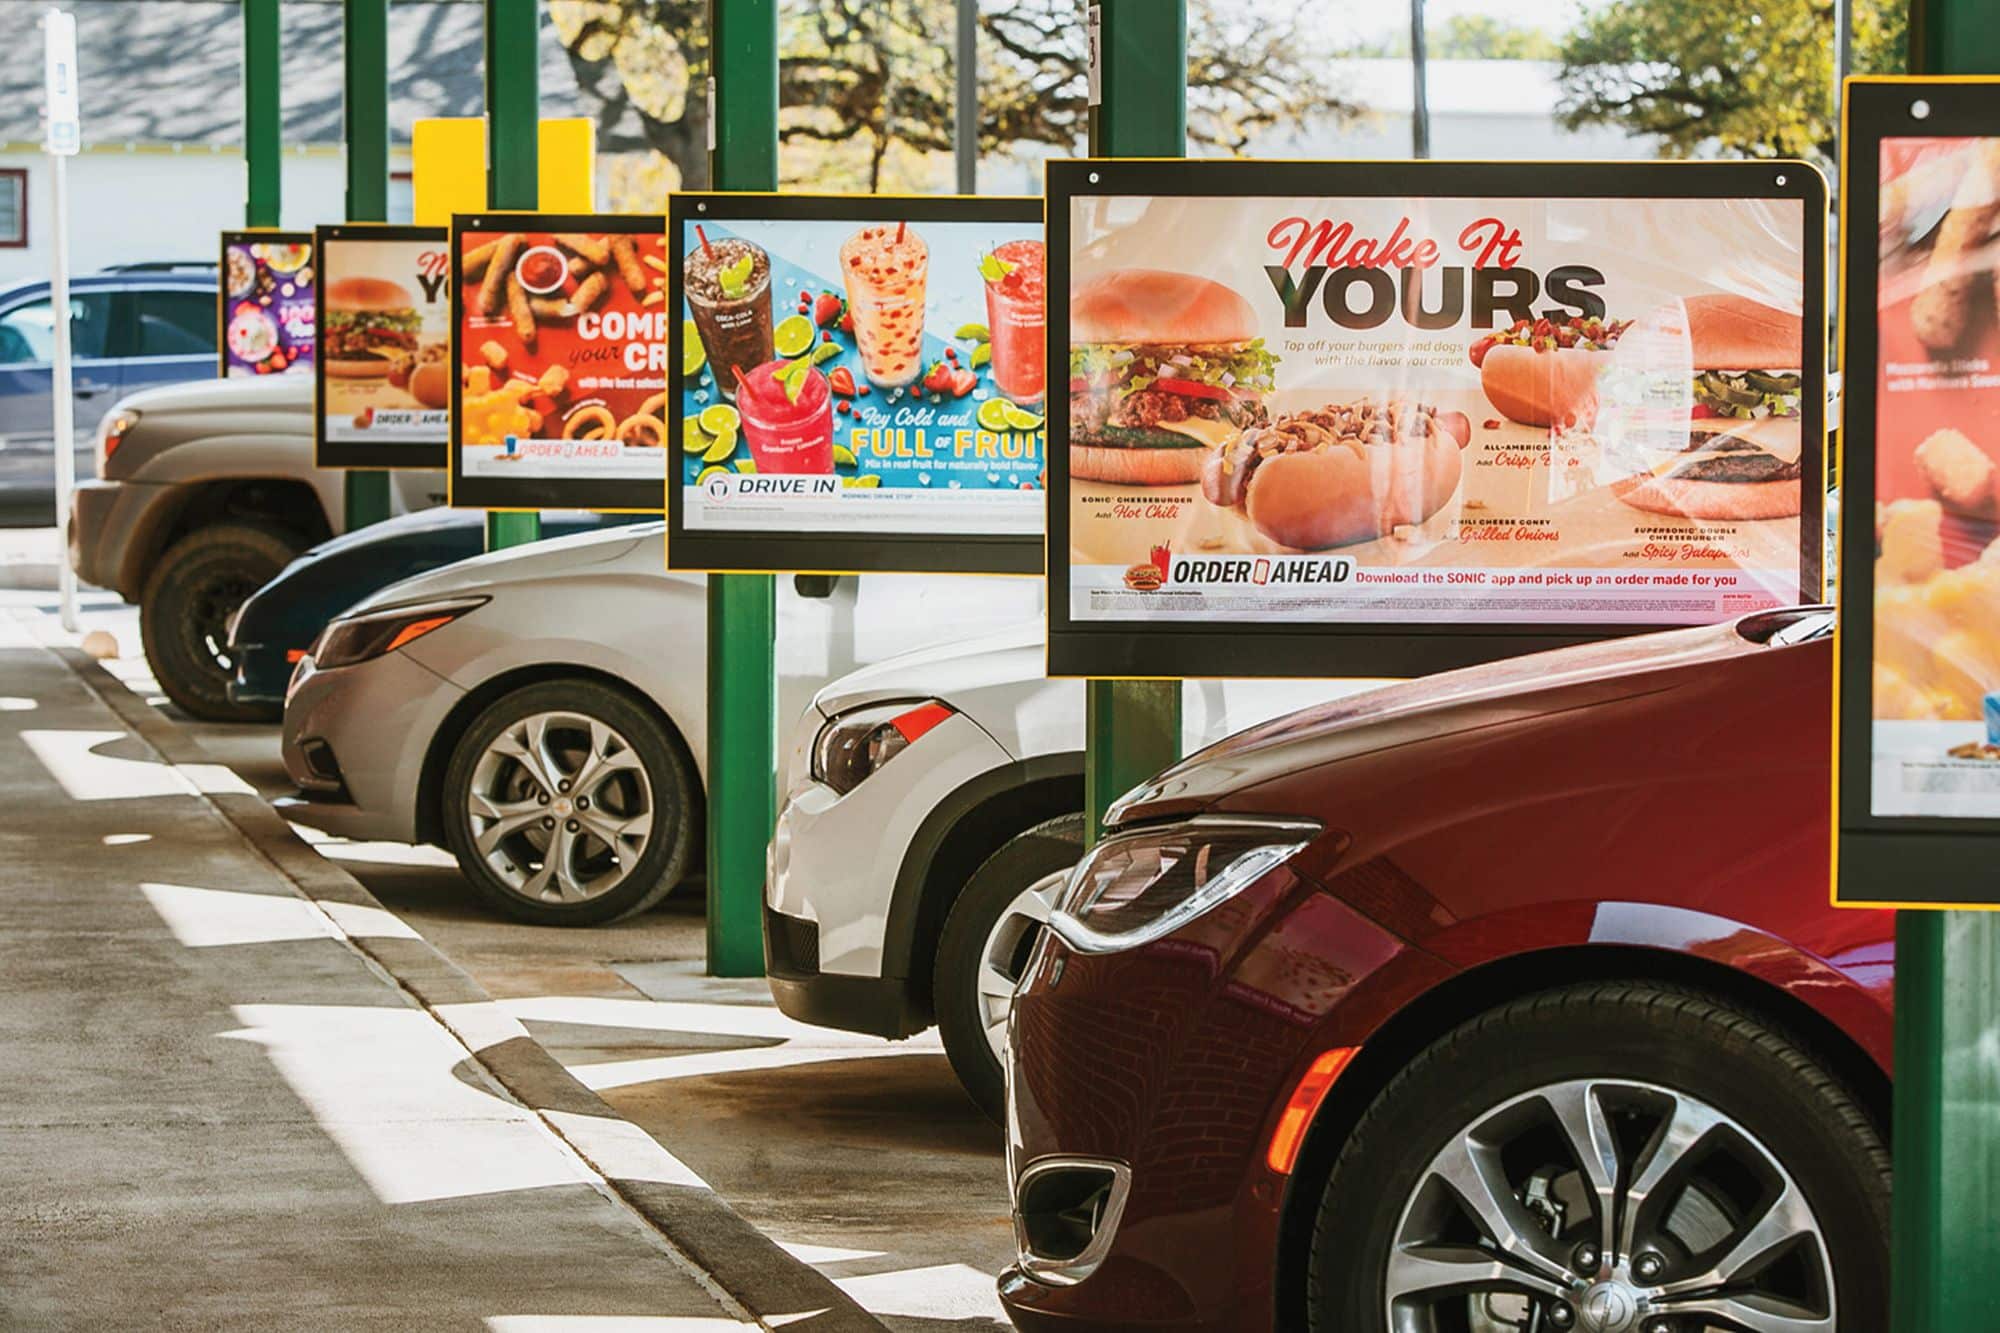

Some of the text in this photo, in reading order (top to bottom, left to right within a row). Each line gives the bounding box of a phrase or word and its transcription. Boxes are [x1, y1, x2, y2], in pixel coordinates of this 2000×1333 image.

[1267, 216, 1523, 271] Make It
[416, 273, 448, 304] Y
[1264, 264, 1607, 330] YOURS
[1284, 340, 1305, 353] Top
[1308, 340, 1325, 351] off
[1327, 342, 1355, 353] your
[1358, 341, 1405, 354] burgers
[1434, 341, 1463, 354] dogs
[569, 346, 618, 369] your
[1315, 355, 1341, 366] with
[1345, 355, 1364, 366] the
[1368, 354, 1401, 366] flavor
[1430, 356, 1463, 367] crave
[862, 406, 972, 429] Icy Cold and
[519, 444, 561, 457] ORDER
[574, 443, 619, 457] AHEAD
[851, 428, 934, 457] FULL
[935, 435, 952, 449] OF
[865, 459, 882, 469] Mix
[883, 459, 892, 469] in
[893, 459, 911, 469] real
[912, 459, 932, 469] fruit
[934, 459, 948, 470] for
[949, 460, 989, 472] naturally
[1011, 461, 1039, 471] flavor
[1495, 452, 1536, 470] Crispy
[739, 479, 836, 493] DRIVE IN
[1113, 504, 1142, 519] Hot
[1145, 504, 1180, 519] Chili
[1460, 526, 1513, 545] Grilled
[1515, 526, 1560, 541] Onions
[1641, 543, 1678, 560] Spicy
[1174, 558, 1350, 584] ORDER AHEAD
[1356, 571, 1737, 588] Download the SONIC app and pick up an order made for you
